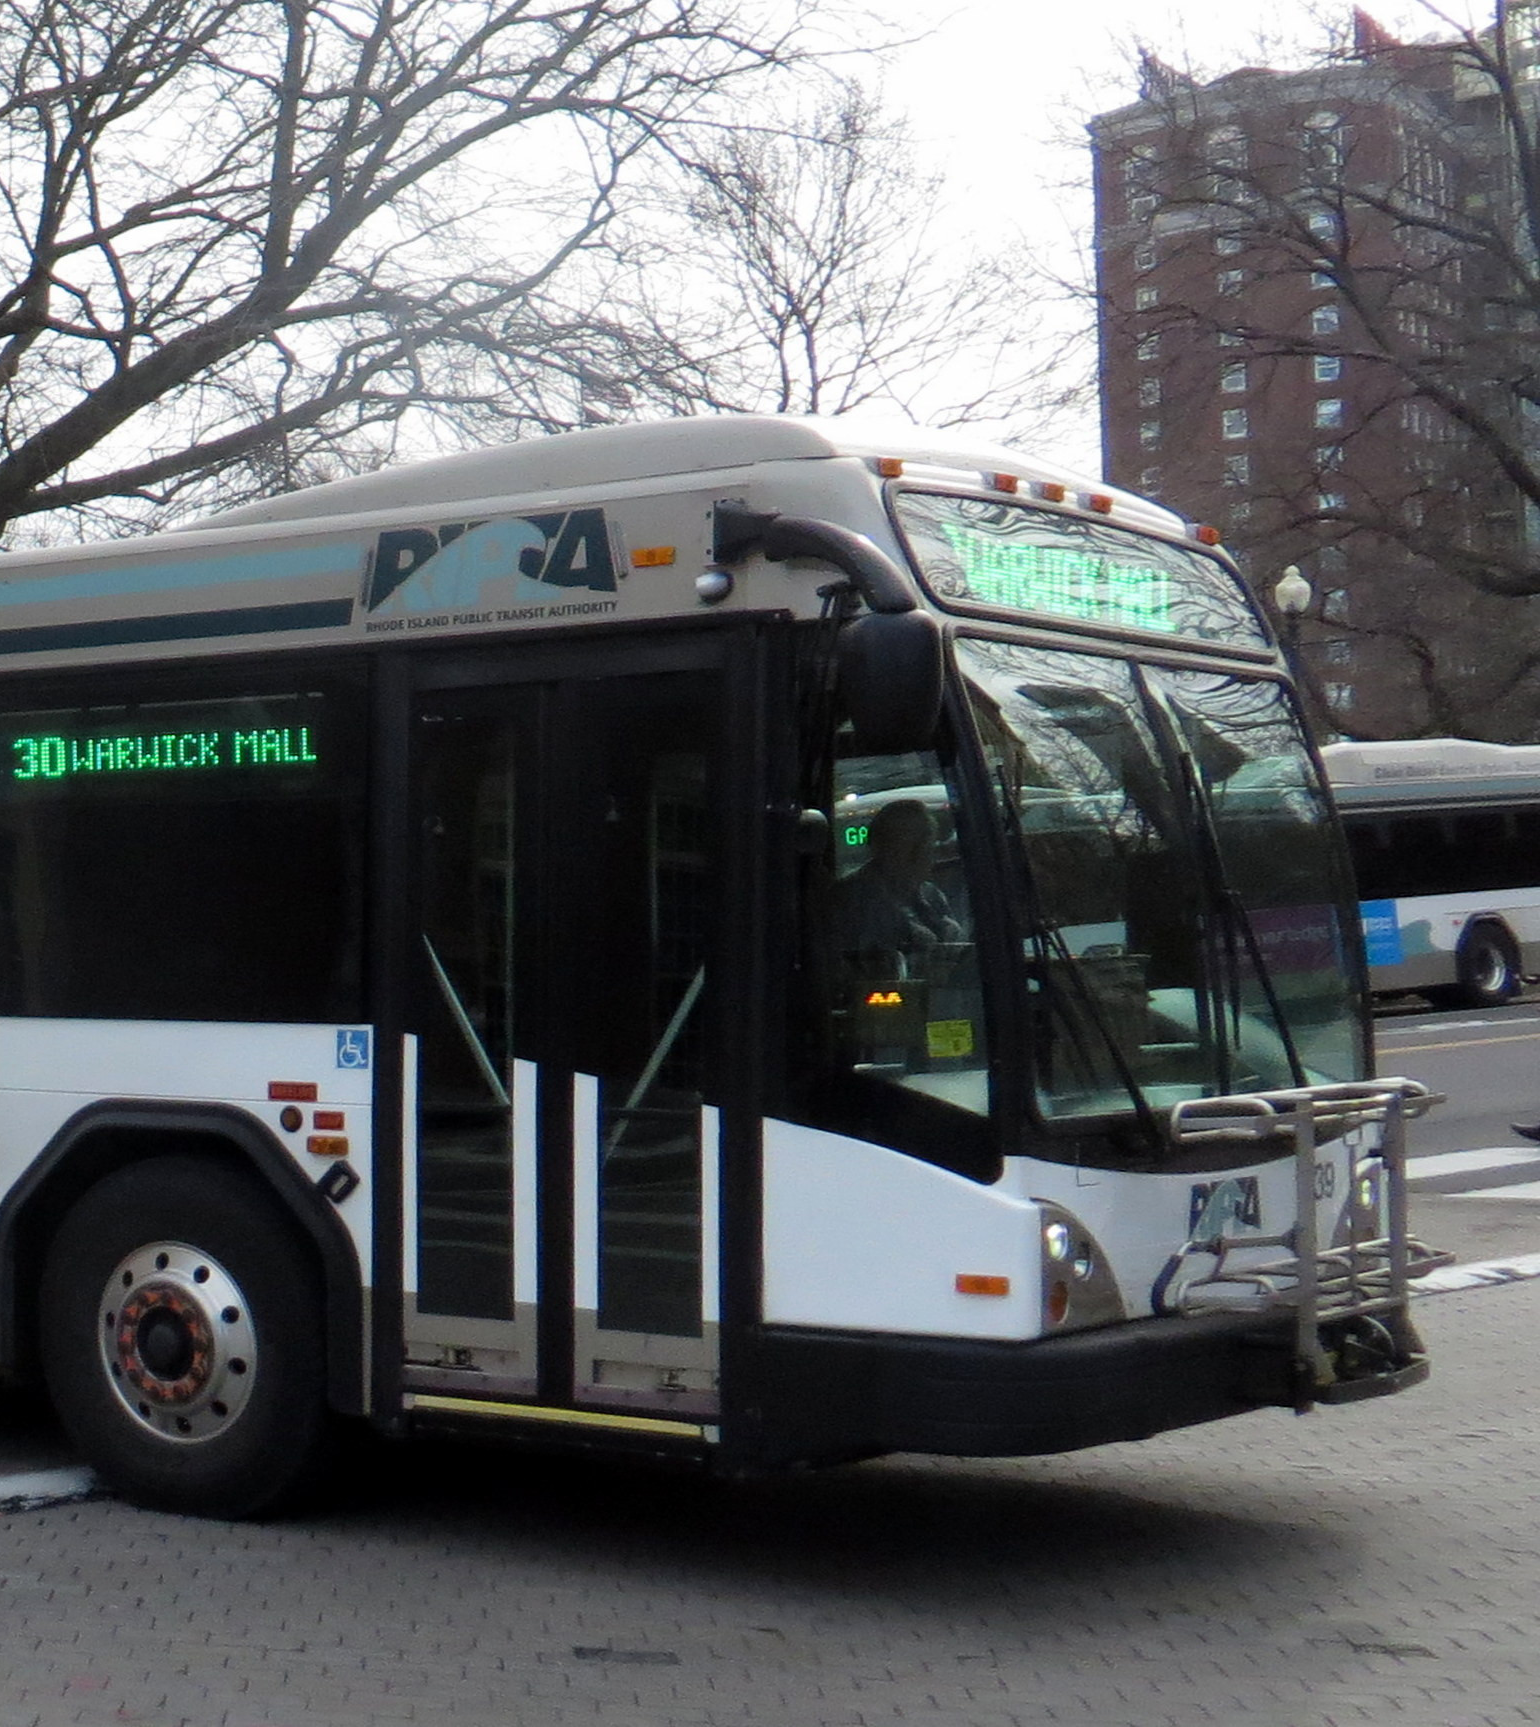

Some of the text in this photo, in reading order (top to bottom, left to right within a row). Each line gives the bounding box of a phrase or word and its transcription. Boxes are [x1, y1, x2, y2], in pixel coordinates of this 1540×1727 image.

[366, 600, 620, 633] RHODE ISLAND PUBLIC TRANSIT AUTHORITY
[13, 726, 318, 779] 30 WARWICK MALL
